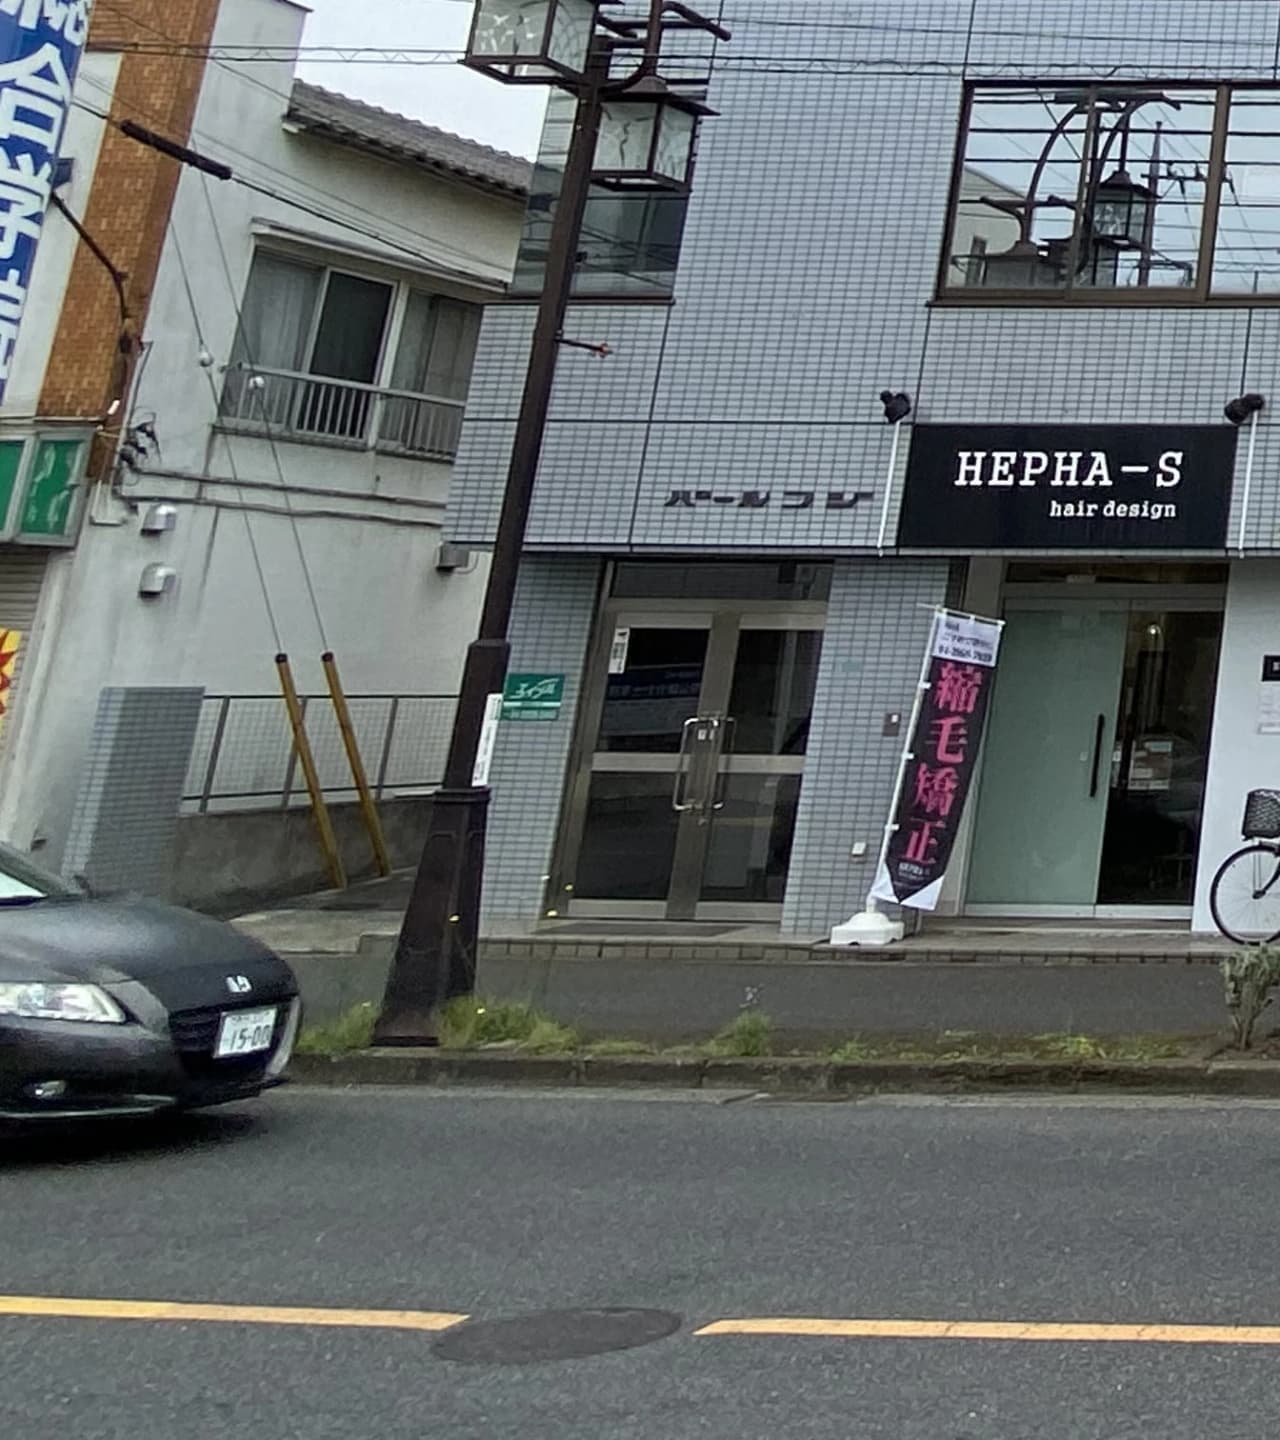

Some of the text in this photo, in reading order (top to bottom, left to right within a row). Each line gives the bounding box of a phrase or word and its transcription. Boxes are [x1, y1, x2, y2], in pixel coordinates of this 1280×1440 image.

[954, 451, 1184, 488] HEPHA-S
[1050, 500, 1176, 520] hair design
[902, 662, 983, 864] 縮毛矯正
